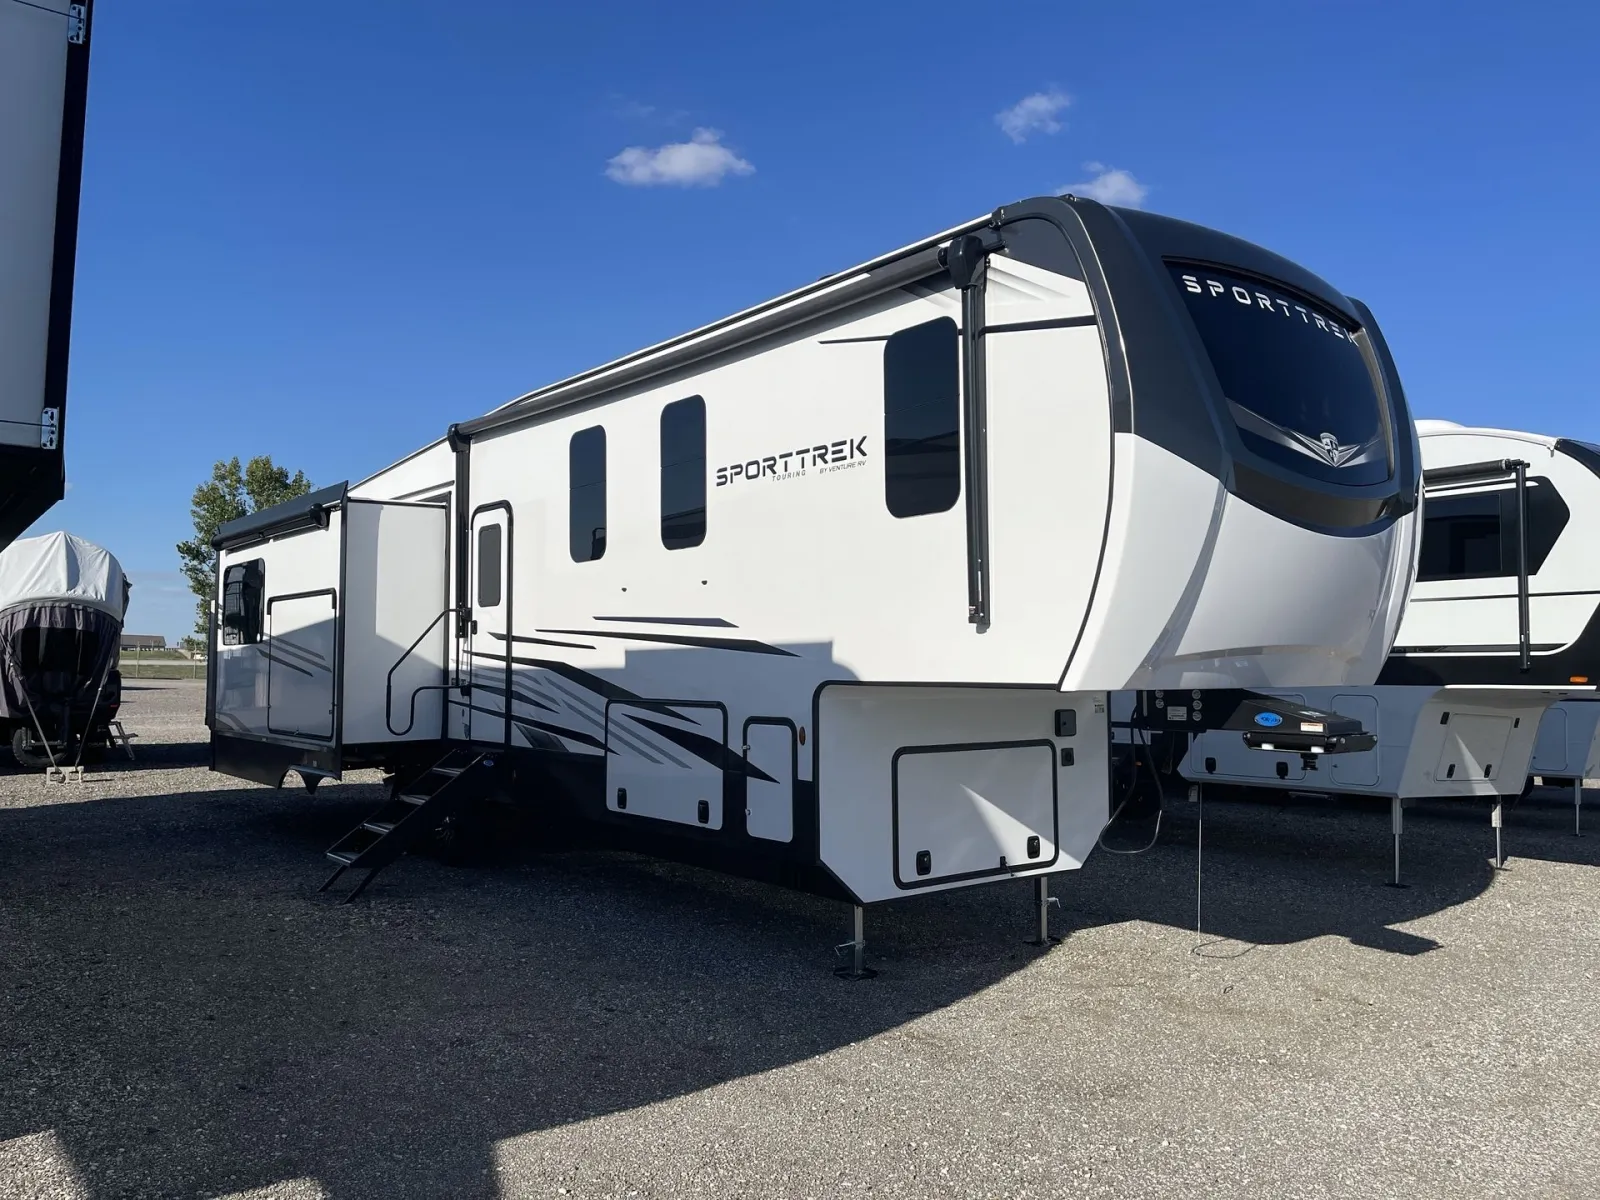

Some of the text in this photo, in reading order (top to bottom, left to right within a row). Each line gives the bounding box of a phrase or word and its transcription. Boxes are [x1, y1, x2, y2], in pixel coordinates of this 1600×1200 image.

[1182, 275, 1360, 347] SPORTTREK
[716, 435, 868, 487] SPORTTREK
[772, 469, 806, 482] TOURING
[819, 459, 867, 475] BY VENTURE RV
